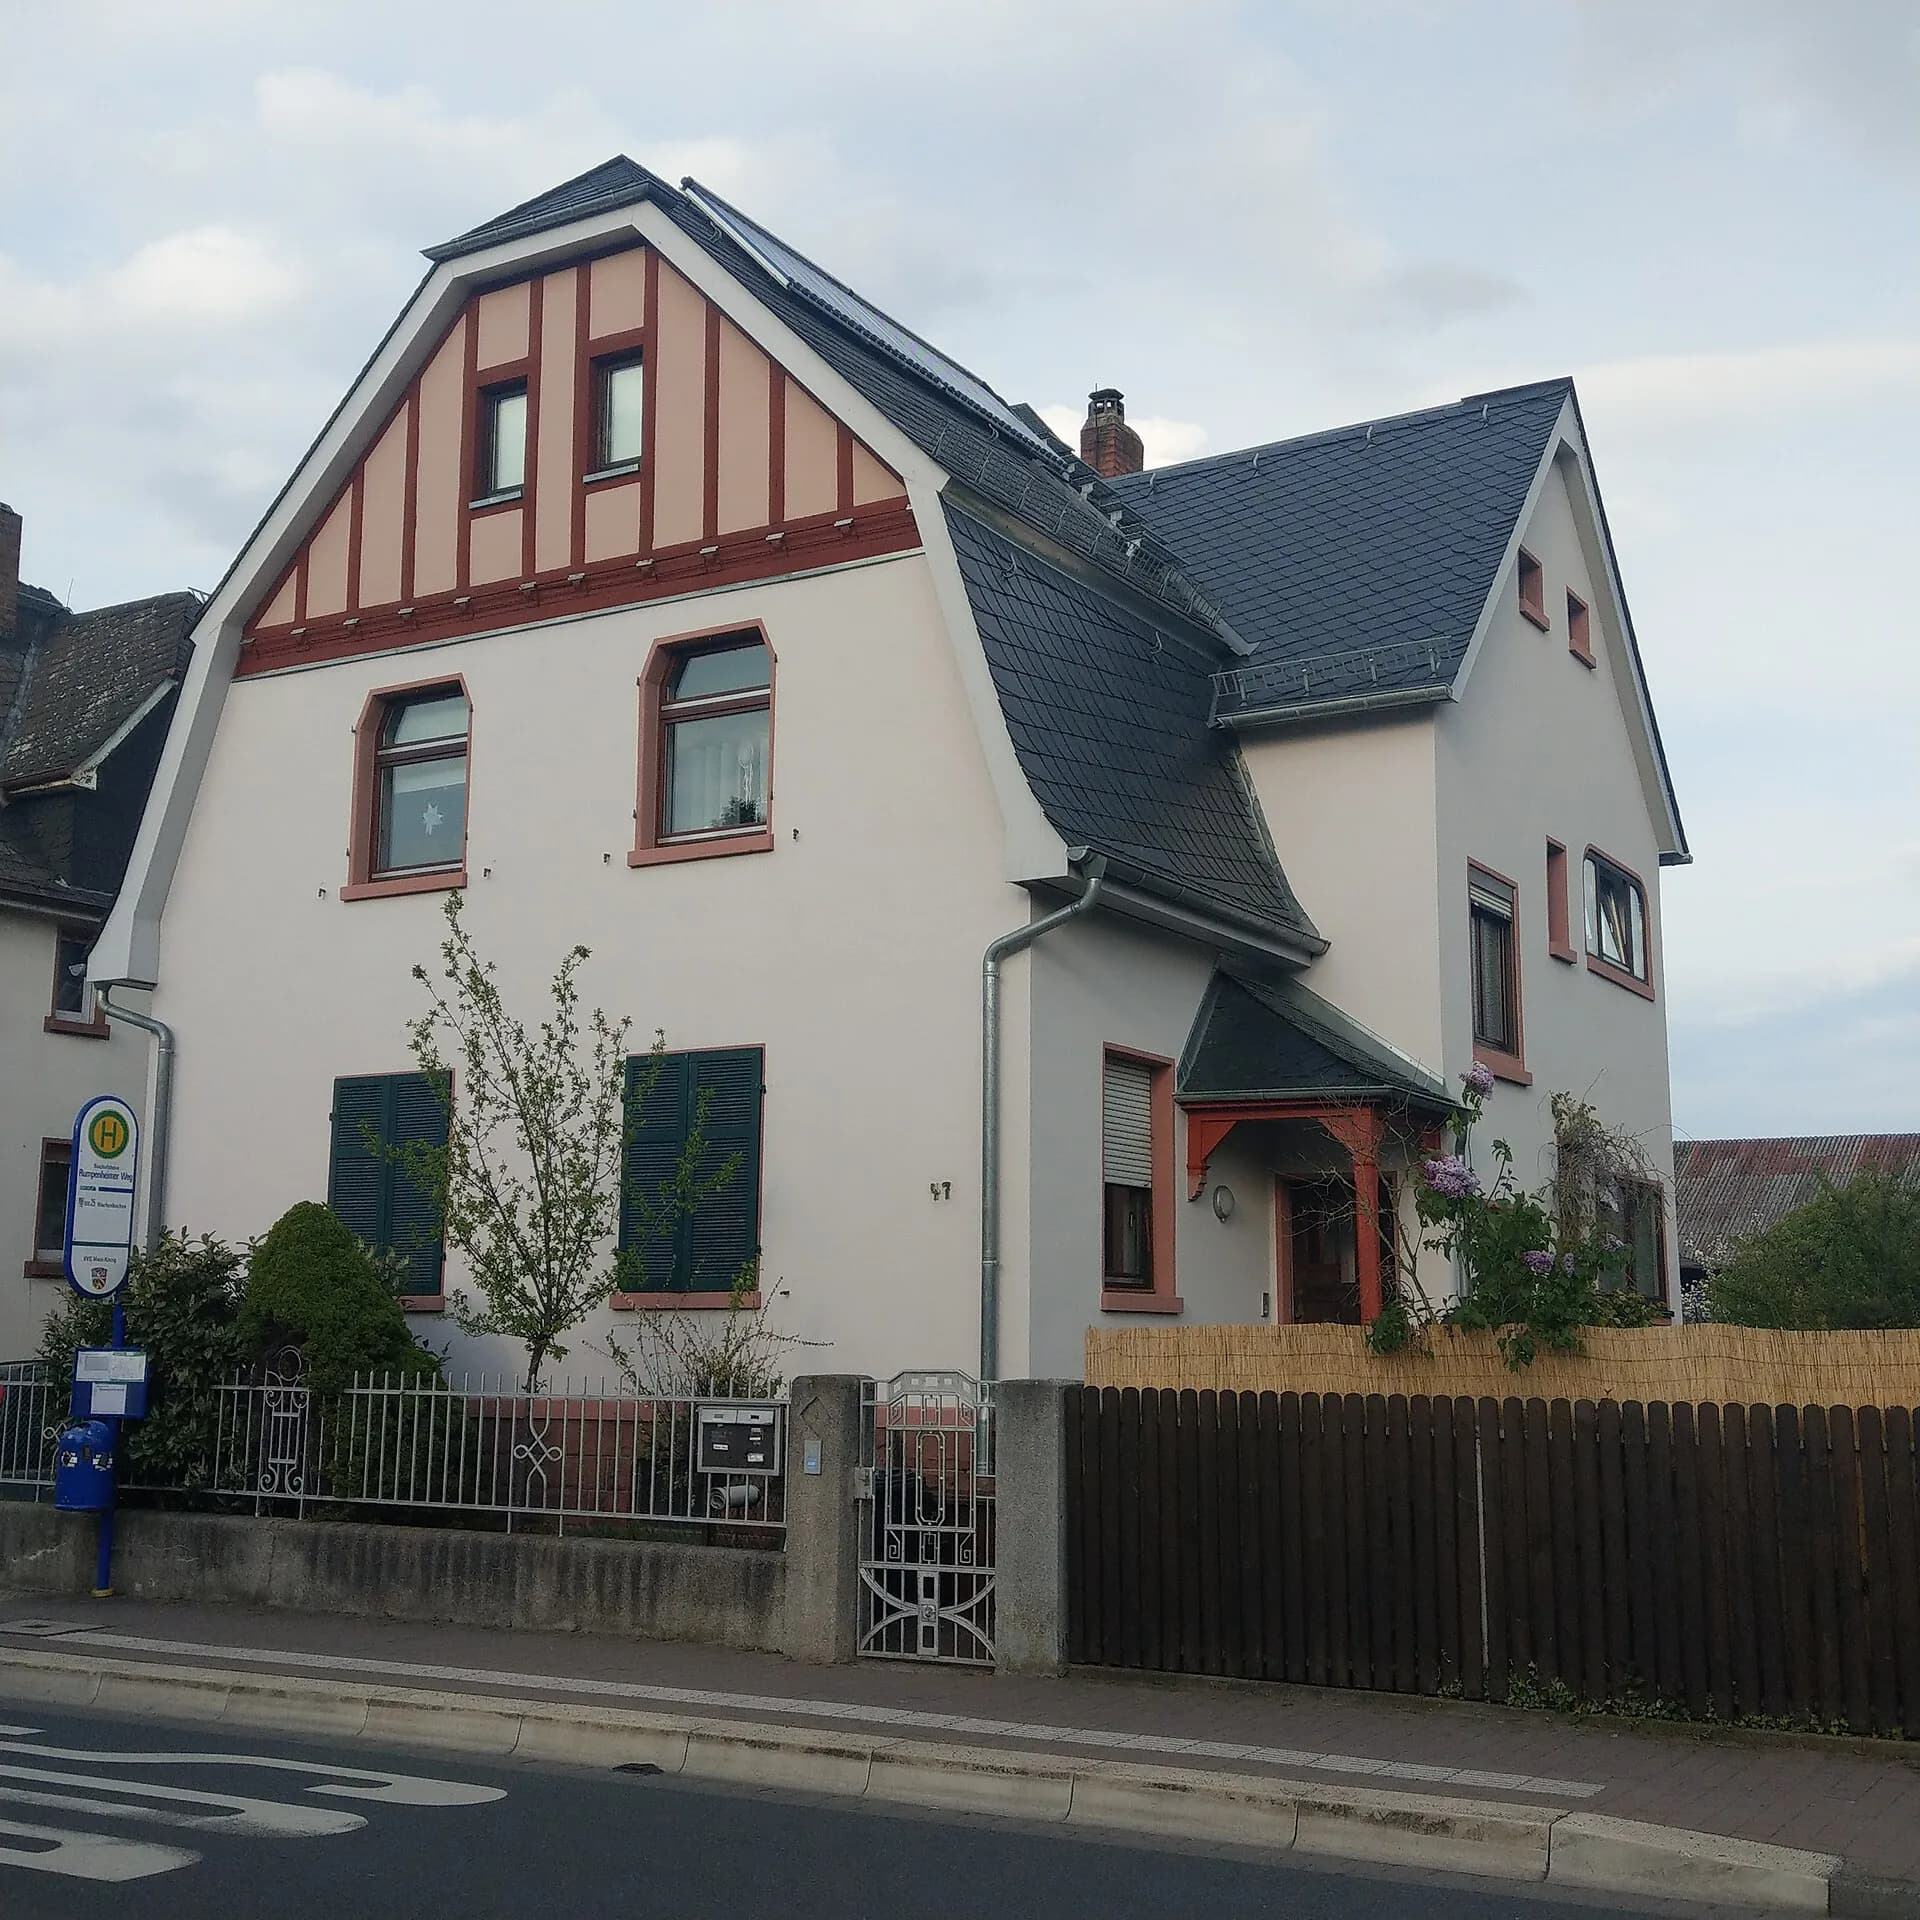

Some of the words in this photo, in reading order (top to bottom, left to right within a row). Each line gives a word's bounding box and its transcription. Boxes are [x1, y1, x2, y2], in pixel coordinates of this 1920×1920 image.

[101, 1120, 117, 1149] H
[120, 1171, 133, 1183] Weg
[930, 1181, 951, 1201] 47
